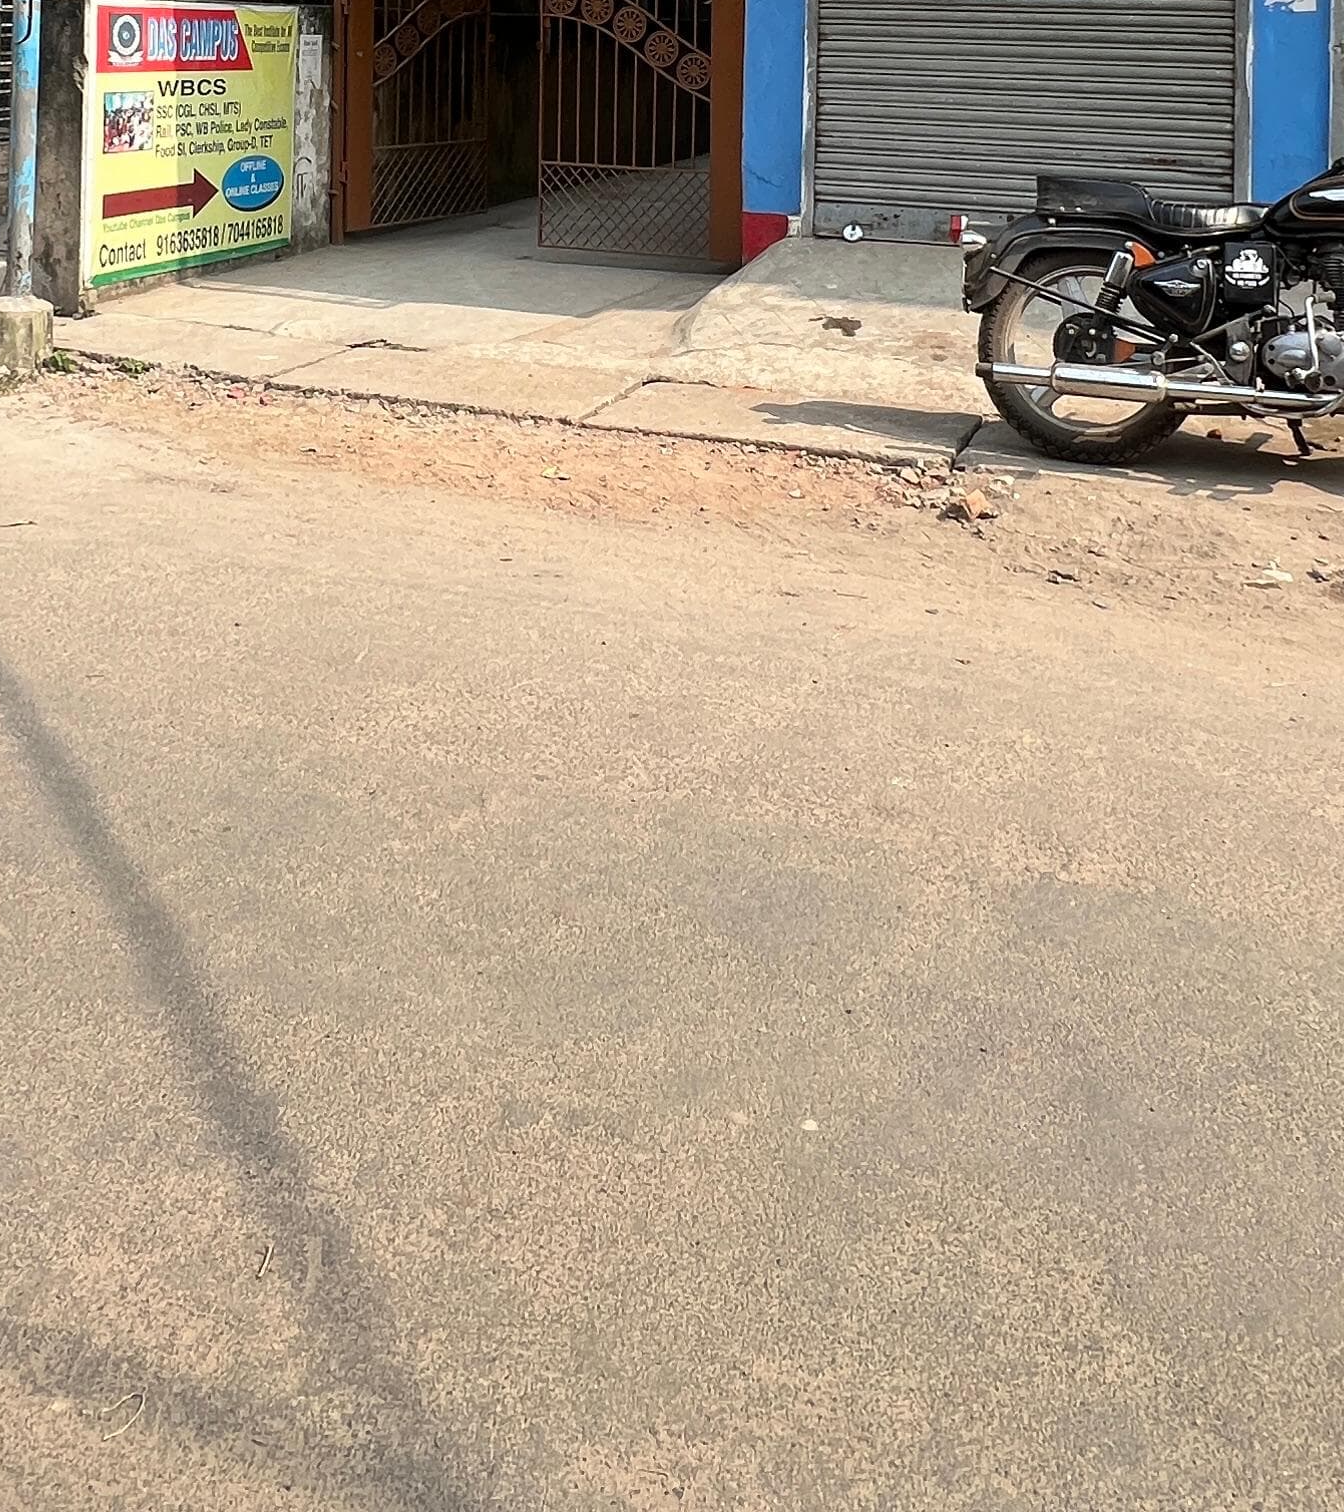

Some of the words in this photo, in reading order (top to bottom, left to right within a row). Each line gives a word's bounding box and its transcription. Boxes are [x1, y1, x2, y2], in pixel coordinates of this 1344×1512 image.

[147, 17, 177, 62] DAS
[179, 17, 239, 62] CAMPUS
[157, 78, 227, 97] WBCS
[156, 105, 173, 119] SSC
[223, 101, 242, 118] MTS)
[196, 122, 209, 136] WB
[235, 117, 253, 135] Lady
[155, 143, 175, 159] Food
[260, 134, 274, 149] TET
[240, 160, 267, 173] OFFLINE
[225, 185, 250, 199] ONLINE
[251, 181, 279, 195] CLASSES
[99, 238, 147, 268] Contact
